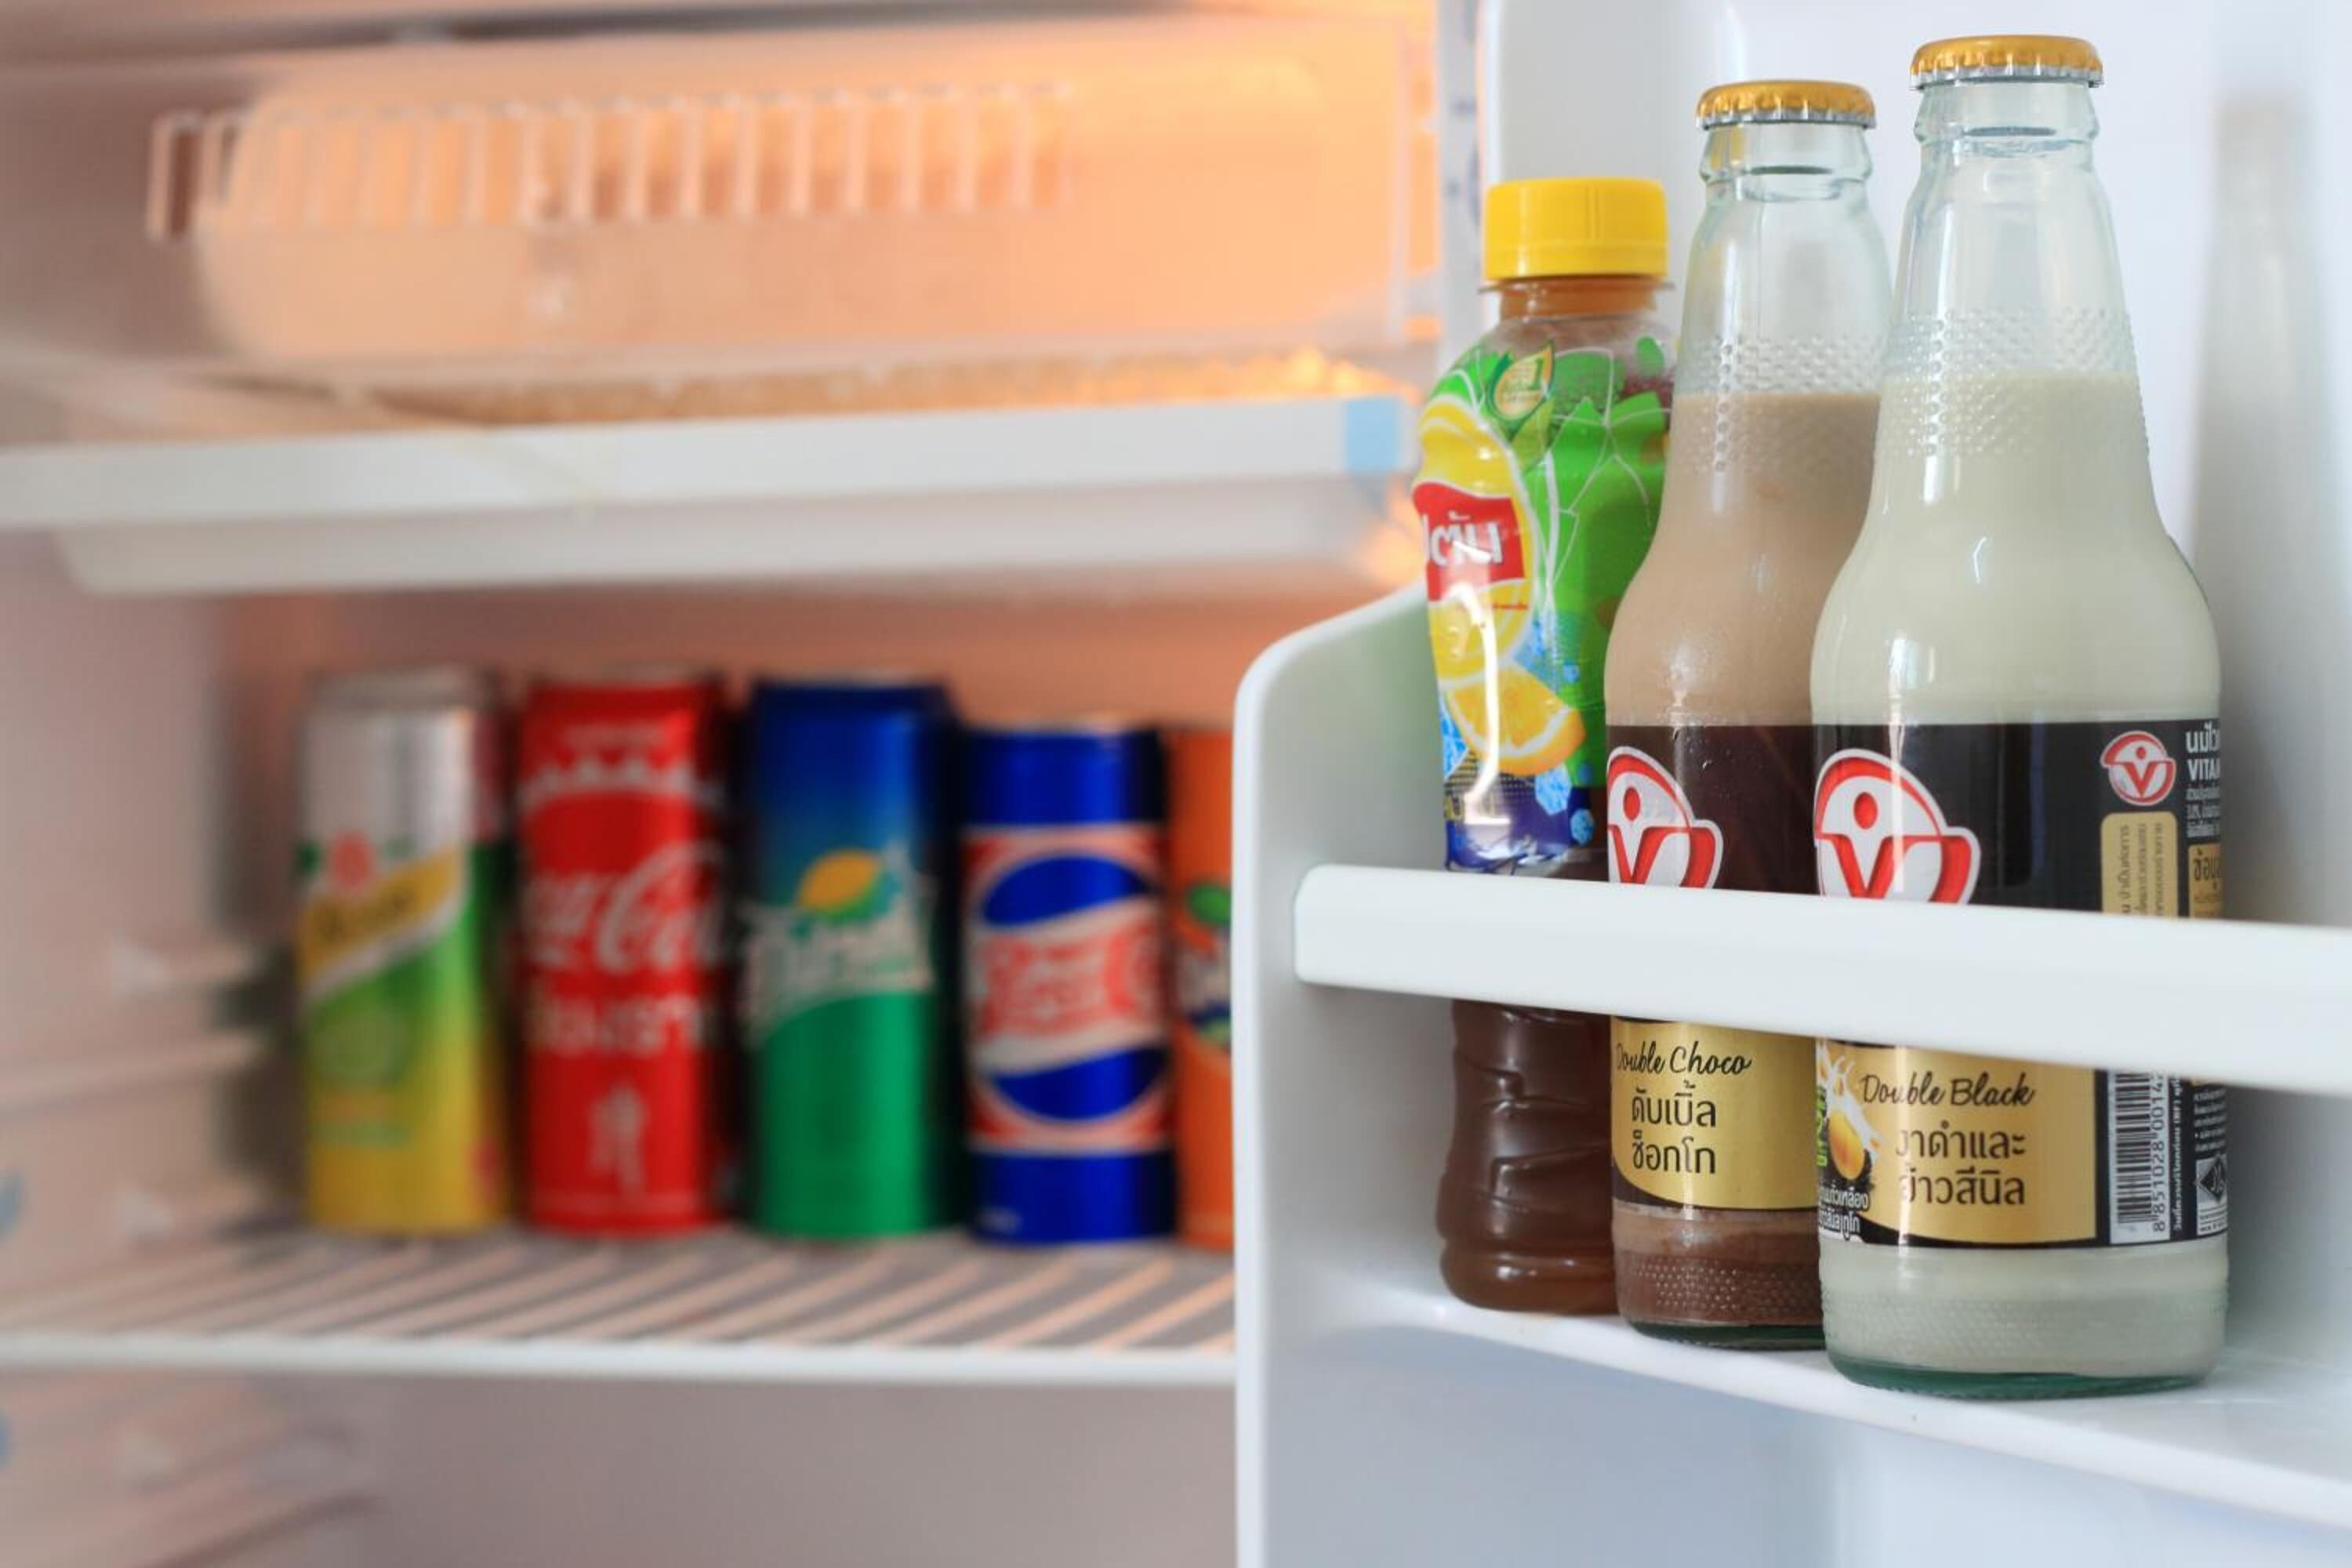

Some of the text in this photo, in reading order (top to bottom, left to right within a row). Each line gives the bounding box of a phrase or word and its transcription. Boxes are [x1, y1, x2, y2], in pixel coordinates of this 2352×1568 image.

[1616, 1040, 1751, 1075] Double Choco
[1632, 1079, 1717, 1128] ดับเบิ้ล
[1860, 1070, 2036, 1107] Double Black
[1632, 1128, 1716, 1174] ช็อกโก
